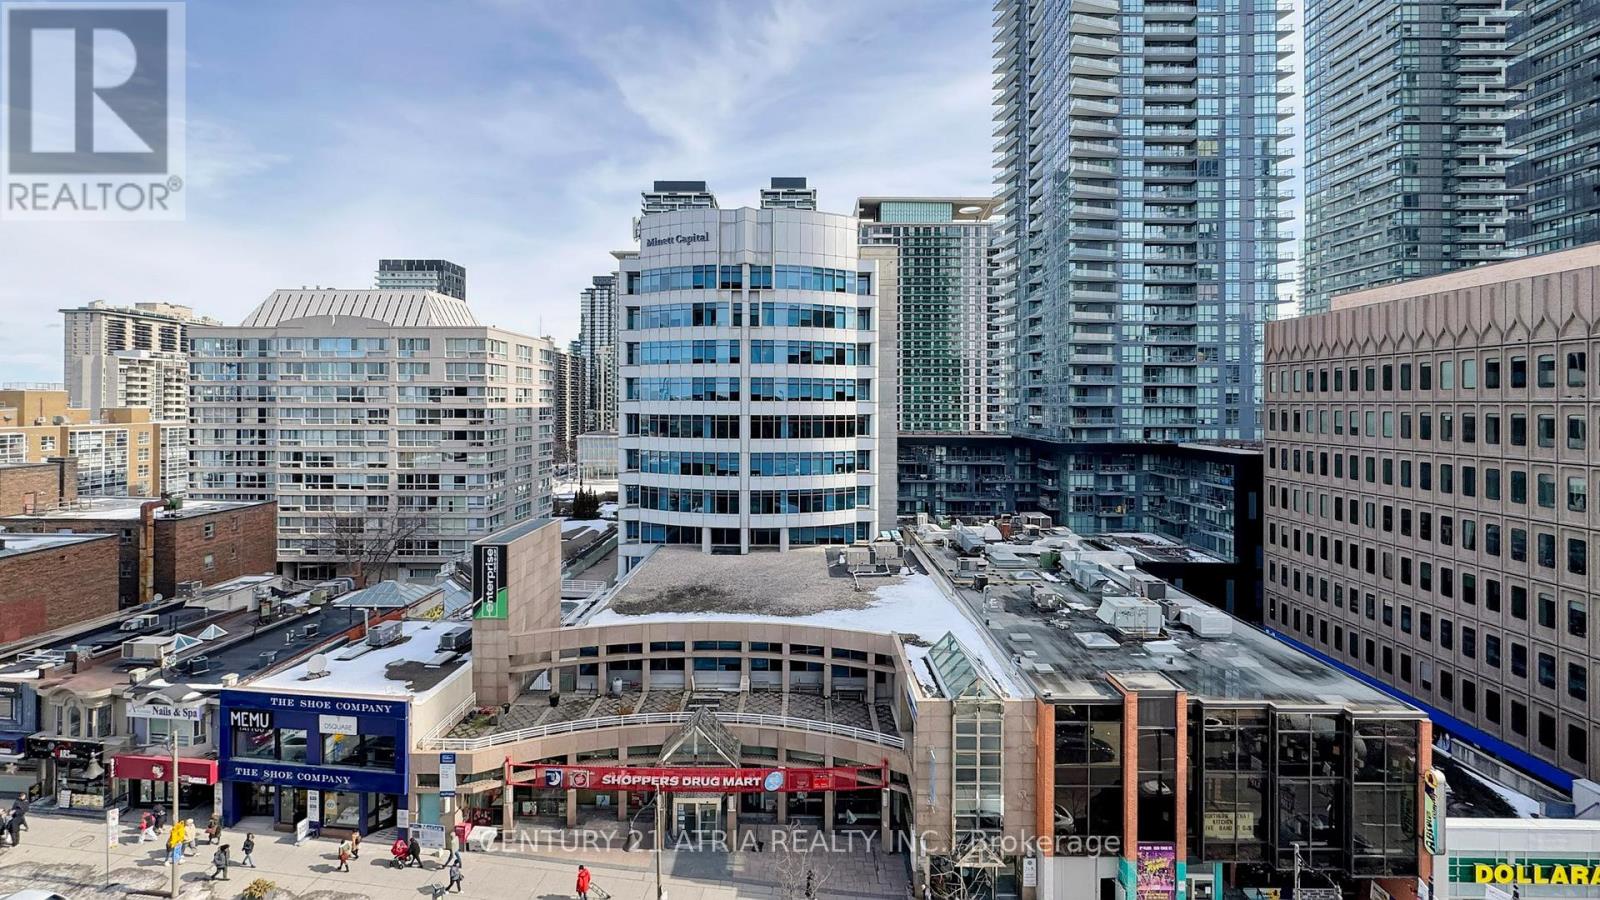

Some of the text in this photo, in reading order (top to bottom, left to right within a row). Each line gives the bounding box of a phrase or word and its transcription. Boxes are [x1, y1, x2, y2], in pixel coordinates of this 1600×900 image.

[646, 232, 709, 247] Minett Capital
[486, 548, 496, 616] enterprise
[152, 704, 171, 716] Nails
[173, 708, 180, 716] &
[182, 708, 197, 720] Spa
[270, 697, 392, 714] THE SHOE COMPANY
[230, 711, 269, 728] MEMU
[235, 769, 350, 785] THE SHOE COMPANY
[602, 774, 762, 787] SHOPPERS DRUG MART
